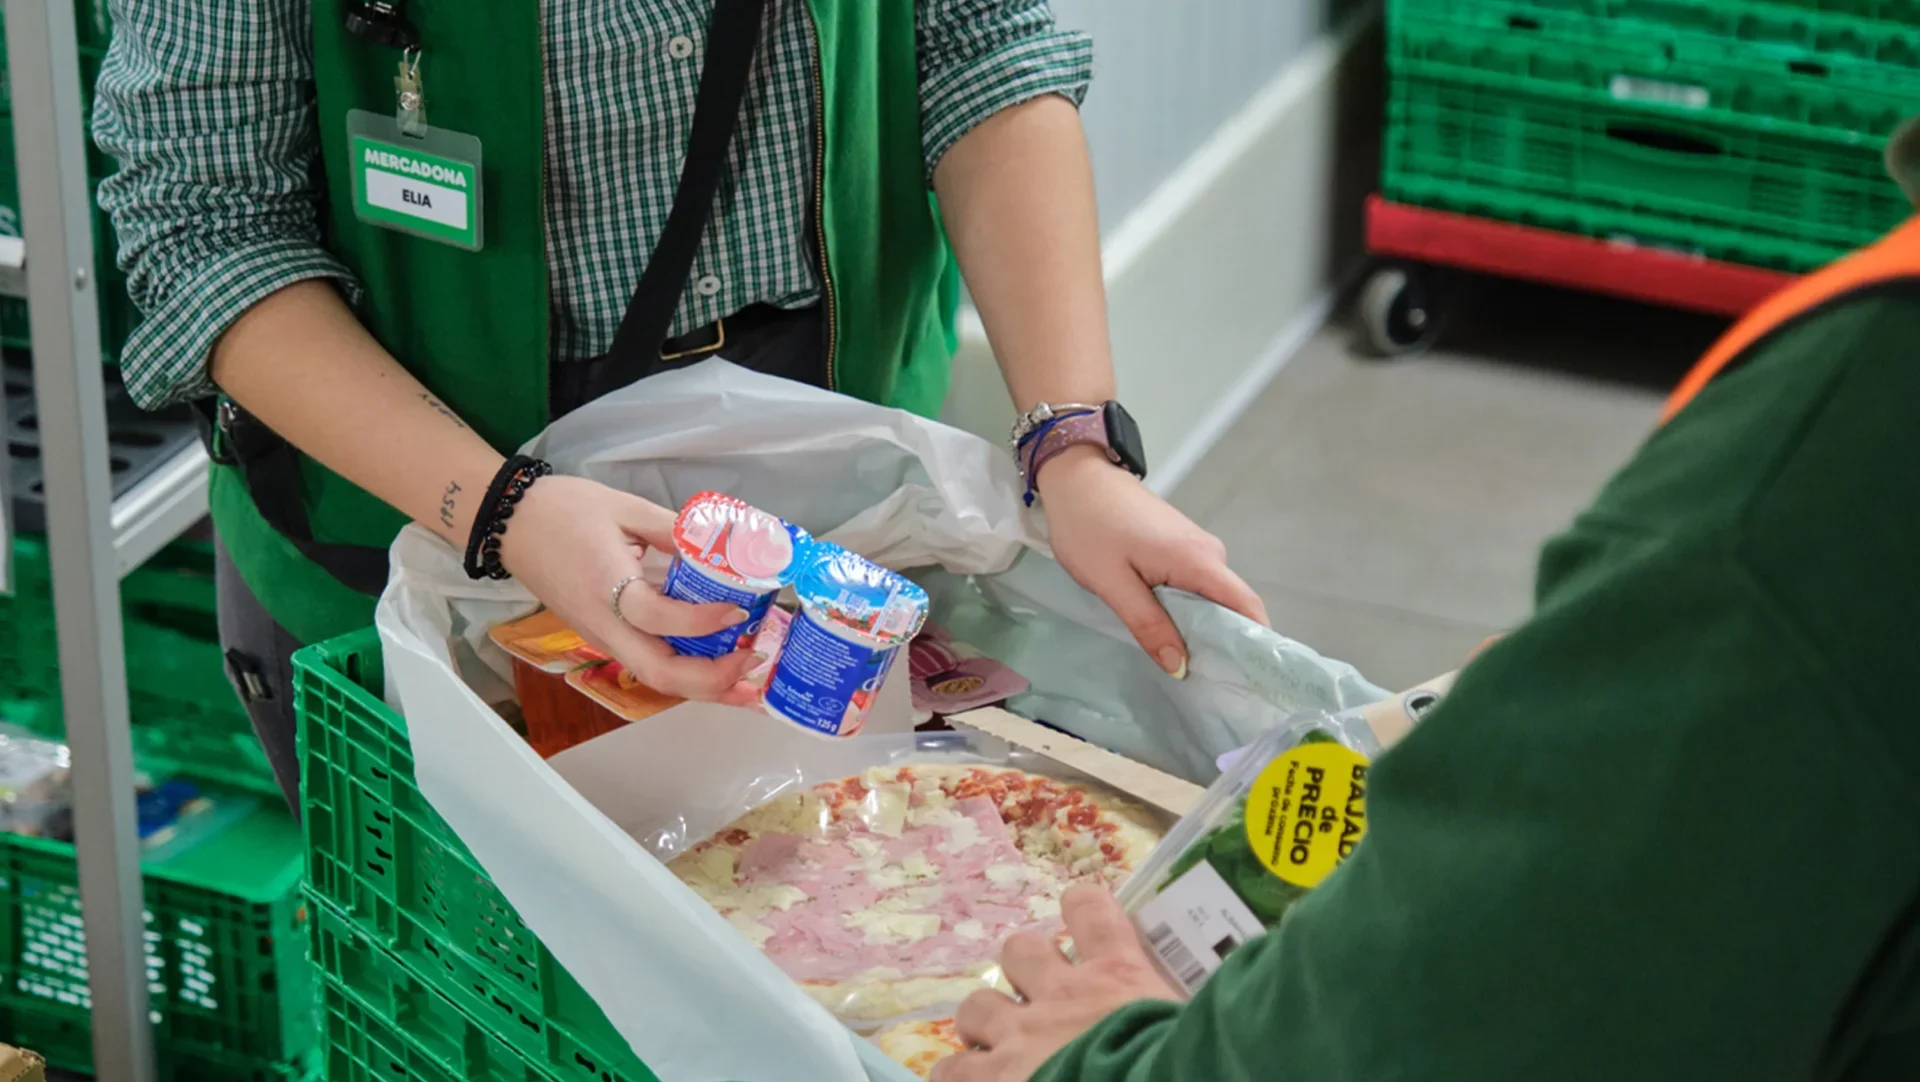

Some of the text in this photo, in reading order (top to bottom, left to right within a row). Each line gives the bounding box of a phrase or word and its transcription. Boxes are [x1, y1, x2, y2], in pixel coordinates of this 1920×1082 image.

[364, 147, 467, 188] MERCADONA
[402, 188, 432, 209] ELIA
[440, 480, 462, 529] 1954
[1284, 760, 1300, 796] Fecha
[1281, 797, 1292, 813] de
[1289, 766, 1326, 866] PRECIO
[1318, 805, 1339, 834] de
[1335, 764, 1368, 866] BAJAD
